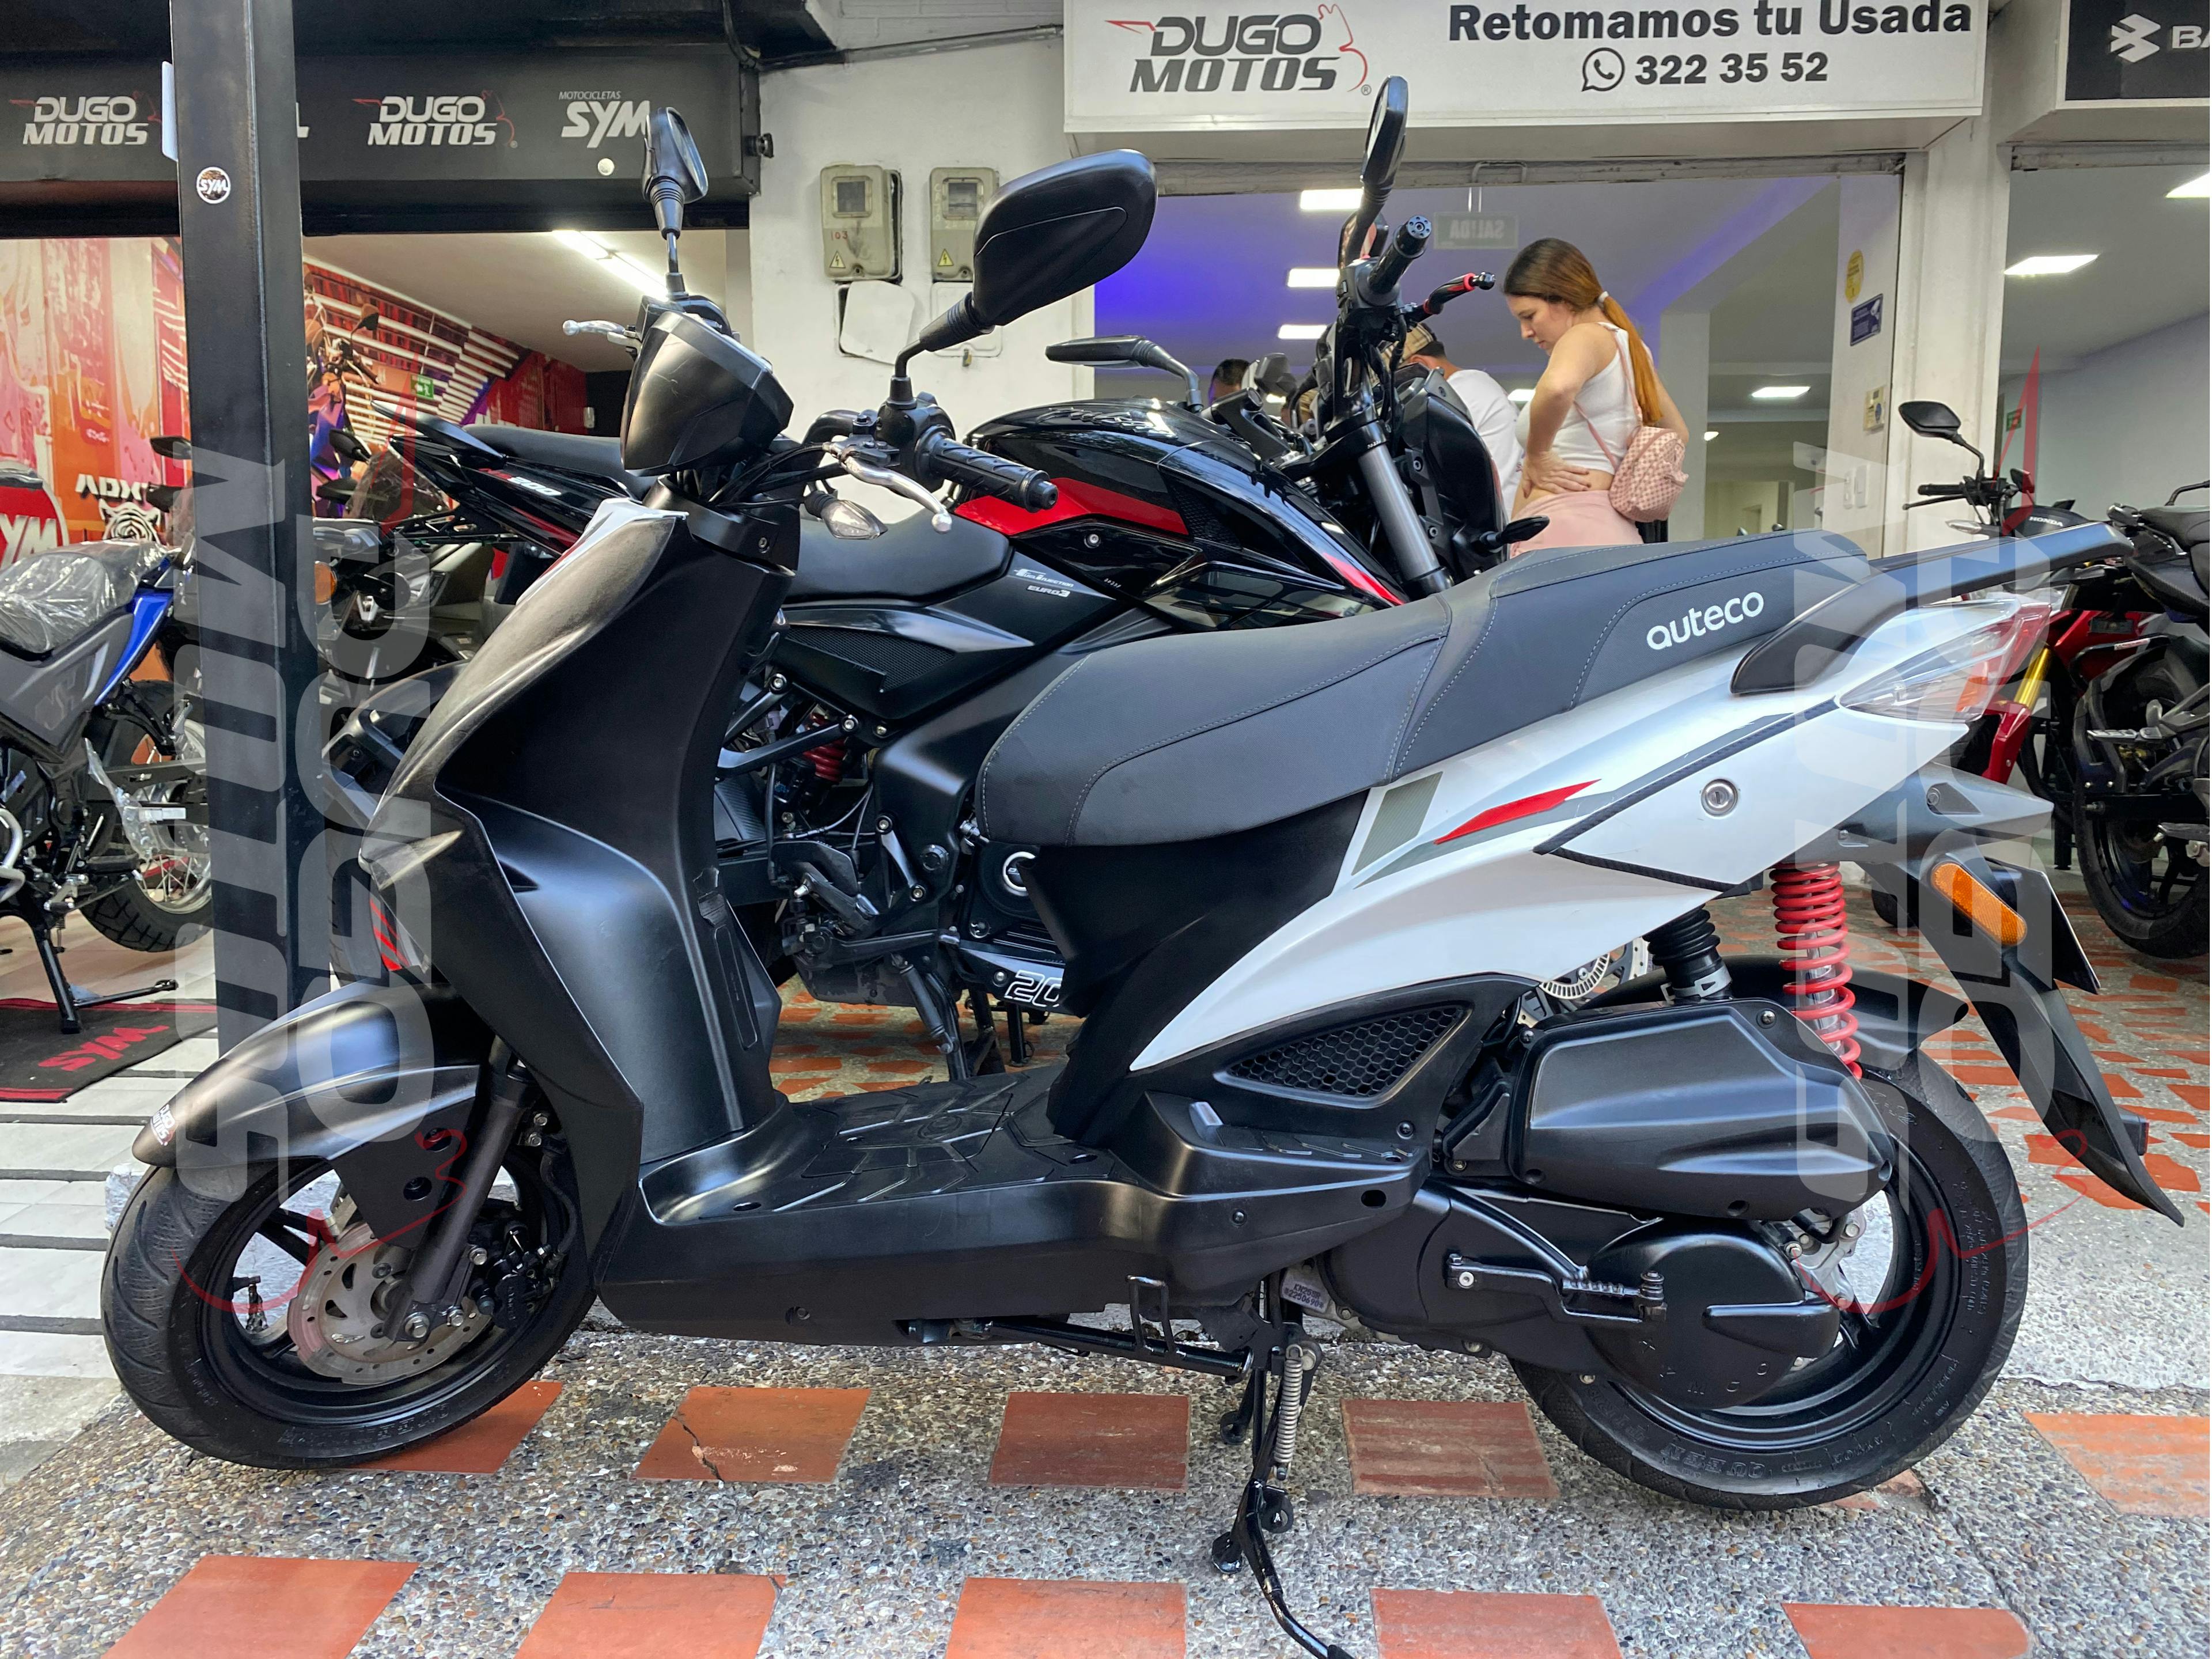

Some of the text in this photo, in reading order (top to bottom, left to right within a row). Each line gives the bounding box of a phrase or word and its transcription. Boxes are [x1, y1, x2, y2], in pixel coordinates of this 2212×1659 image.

[1150, 14, 1321, 56] DUGO
[1449, 0, 1972, 41] Retomamos tu Usada
[1130, 56, 1339, 92] MOTOS
[1634, 52, 1828, 85] 322 35 52
[34, 96, 137, 122] DUGO
[380, 96, 486, 123] DUGO
[559, 91, 622, 100] MOTOCICLETAS
[22, 122, 149, 145] MOTOS
[368, 122, 498, 146] MOTOS
[561, 100, 650, 149] SYM
[198, 179, 229, 195] SYM
[75, 474, 148, 501] ADX
[2028, 516, 2064, 527] HONDA
[0, 513, 58, 570] YM
[1646, 590, 1765, 652] auteco
[37, 1025, 170, 1071] SYM
